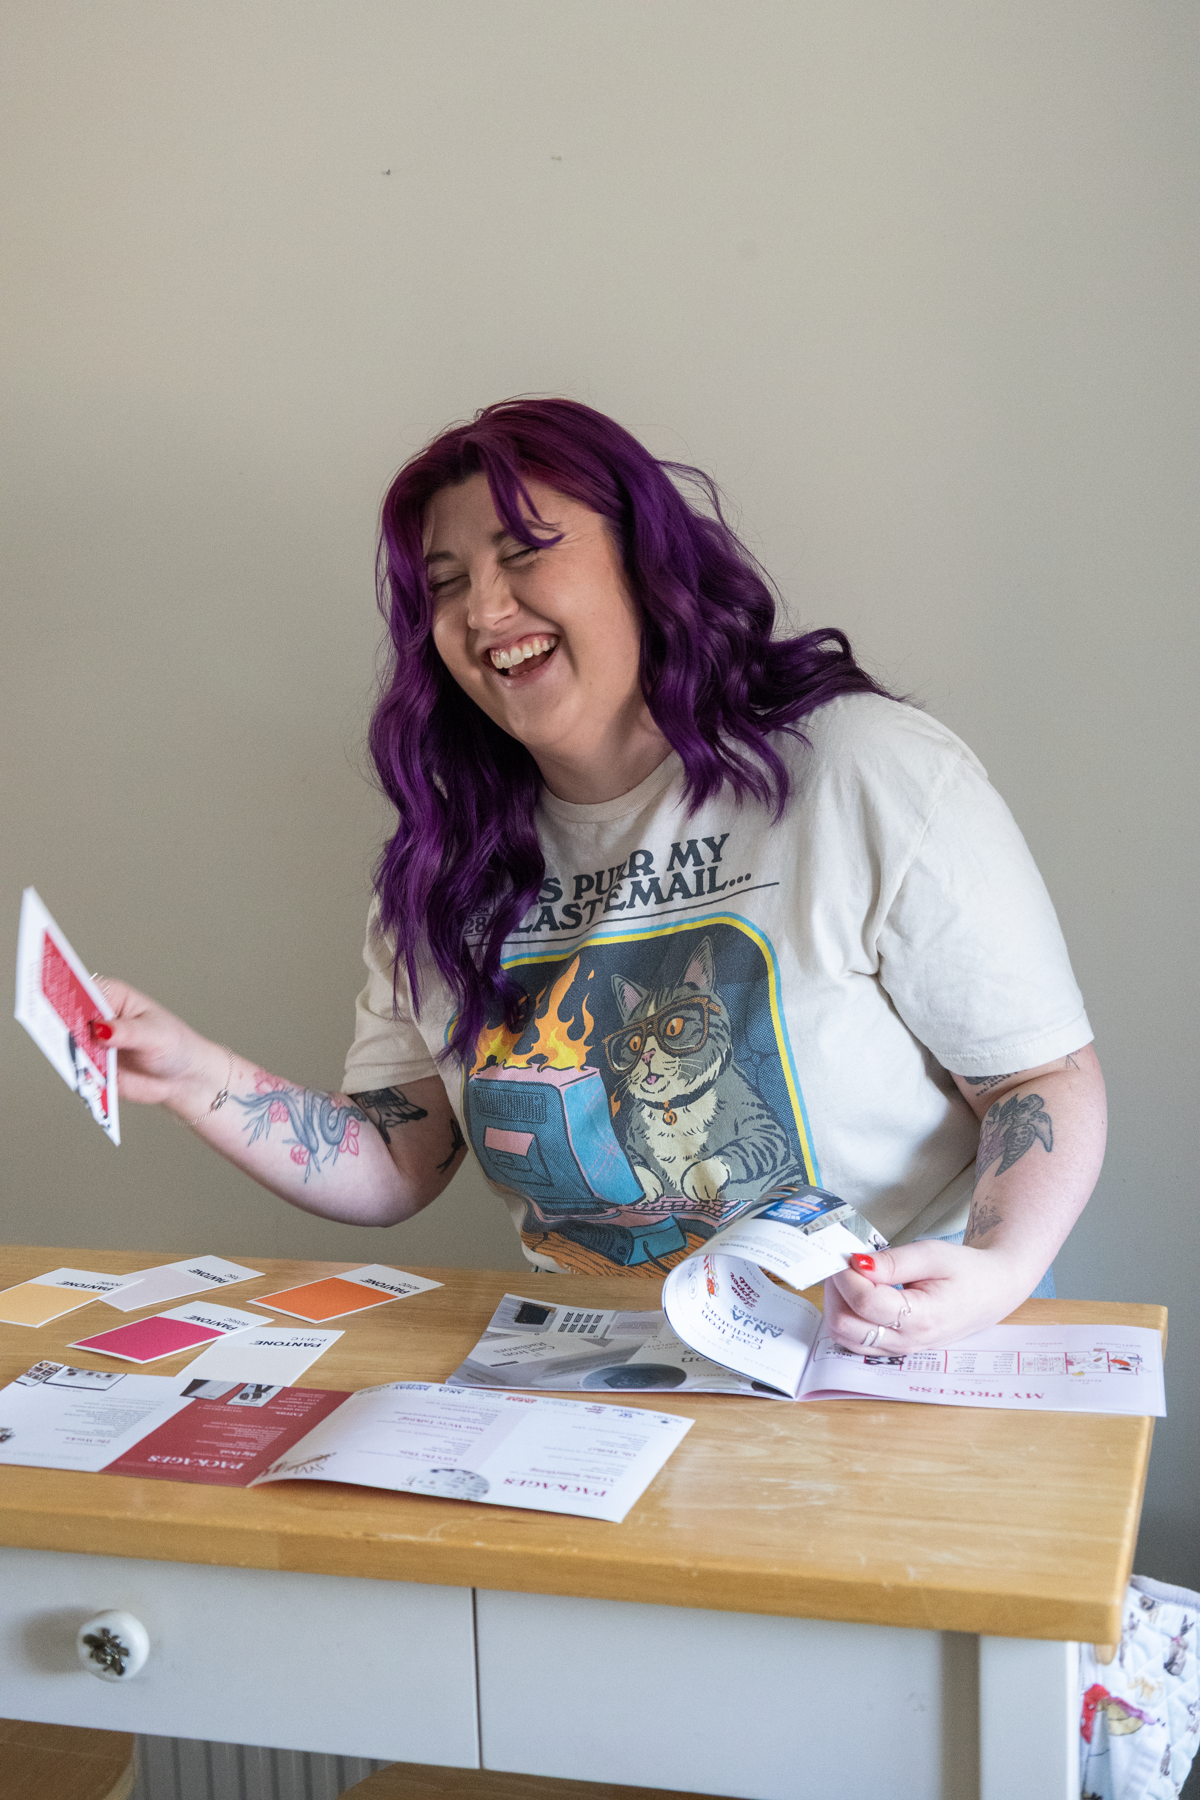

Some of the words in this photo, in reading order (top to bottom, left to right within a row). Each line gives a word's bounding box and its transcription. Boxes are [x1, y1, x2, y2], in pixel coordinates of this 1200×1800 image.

[666, 832, 730, 872] MY
[188, 1268, 230, 1284] PANTONE
[56, 1280, 114, 1292] PANTONE
[360, 1277, 411, 1295] PANTONE
[729, 1271, 758, 1304] sipper
[738, 1276, 761, 1299] club
[730, 1285, 756, 1309] slow
[185, 1314, 239, 1331] PANTONE
[701, 1309, 725, 1335] Iron
[705, 1302, 764, 1344] Radiators
[729, 1308, 783, 1339] ANJA
[732, 1304, 784, 1333] RICHARDS
[252, 1340, 322, 1348] PANTONE
[493, 1341, 547, 1354] Radiators
[530, 1345, 555, 1354] Cast
[730, 1333, 762, 1351] Cast
[908, 1385, 1003, 1399] PROCESS
[1007, 1391, 1046, 1401] MY
[147, 1454, 245, 1470] PACKAGES
[503, 1478, 607, 1498] PACKAGES
